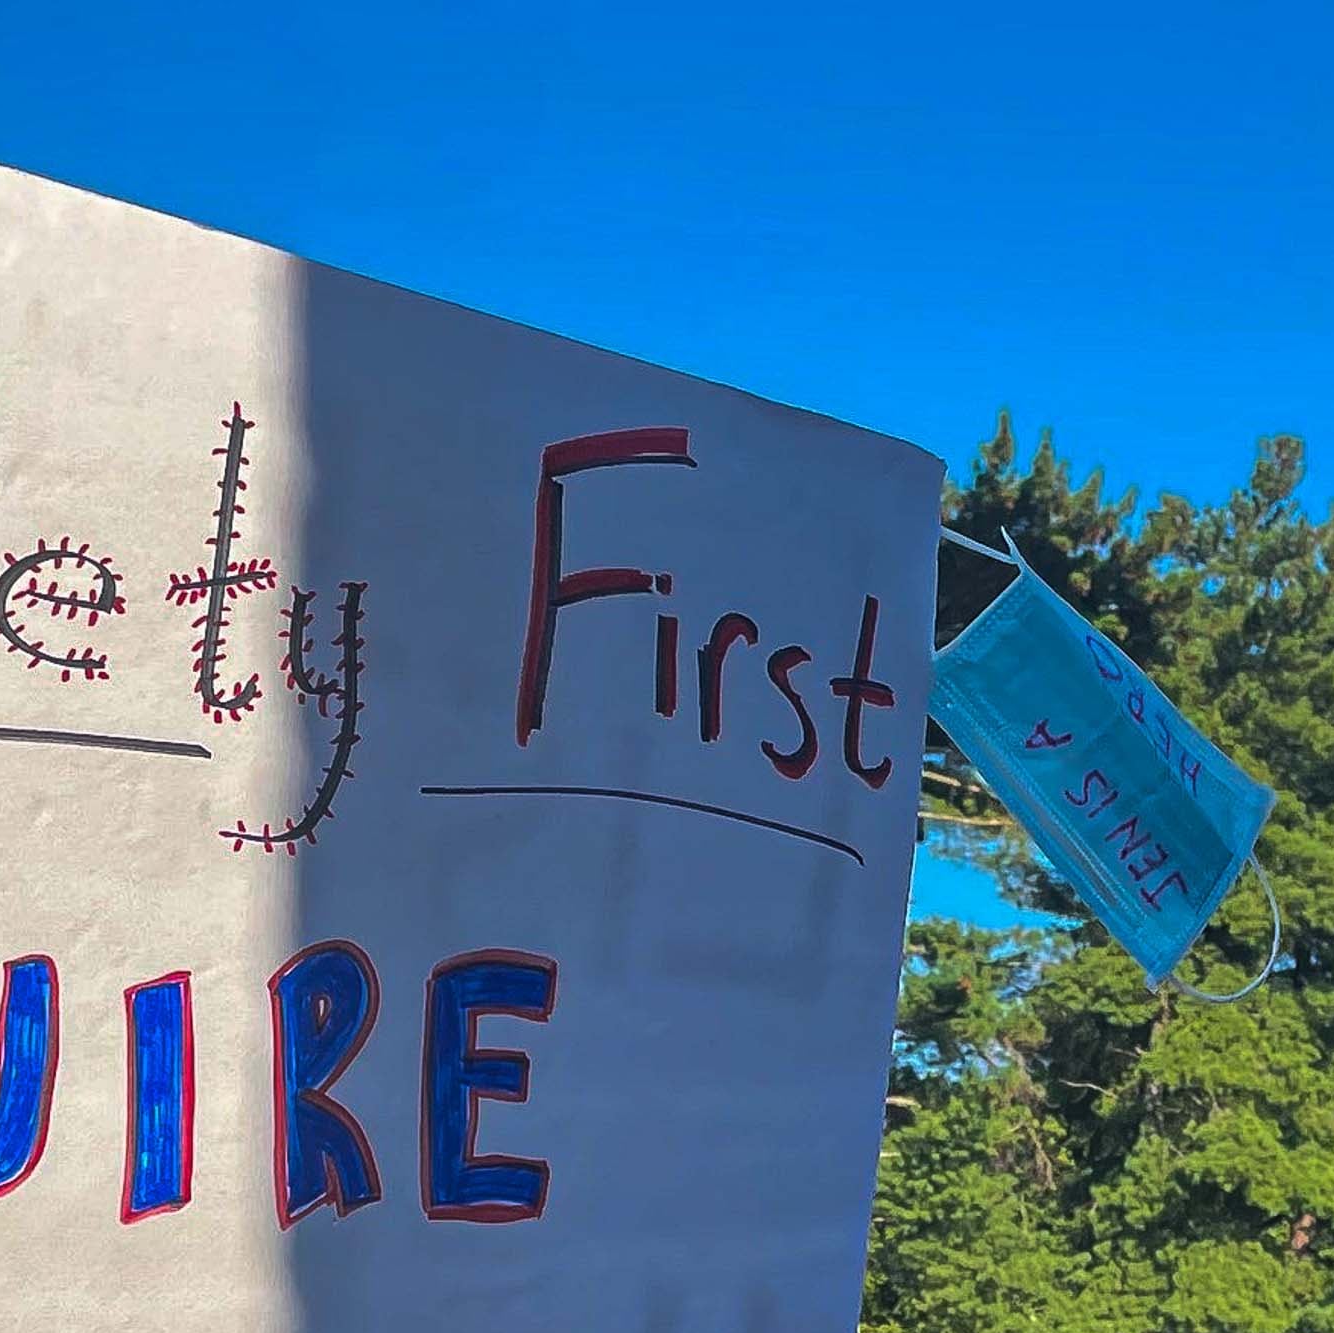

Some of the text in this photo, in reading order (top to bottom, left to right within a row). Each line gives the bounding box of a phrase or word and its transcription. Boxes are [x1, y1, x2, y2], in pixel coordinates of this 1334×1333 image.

[515, 426, 895, 789] First
[1023, 718, 1189, 911] JEN IS A
